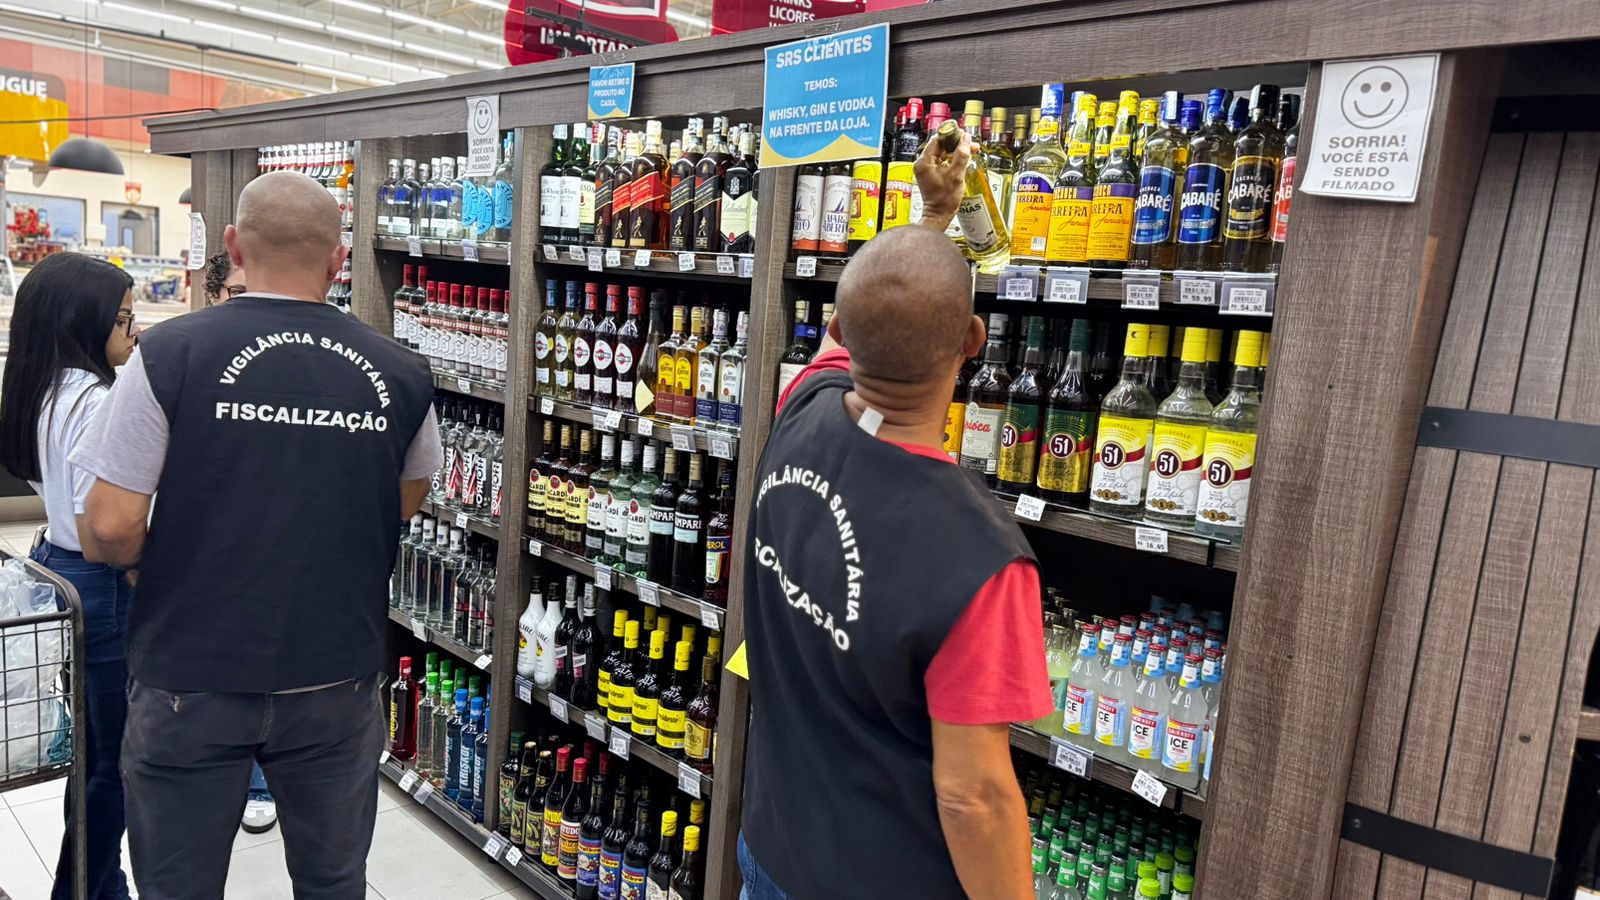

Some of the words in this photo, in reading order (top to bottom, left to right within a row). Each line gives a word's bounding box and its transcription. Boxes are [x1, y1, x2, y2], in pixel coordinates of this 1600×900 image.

[769, 4, 816, 23] LICORES
[776, 49, 802, 69] SRS
[804, 35, 873, 63] CLIENTES
[804, 78, 838, 91] TEMOS:
[769, 105, 808, 121] WHISKY,
[810, 103, 828, 116] GIN
[829, 102, 836, 114] E
[838, 96, 875, 112] VODKA
[769, 127, 783, 139] NA
[784, 121, 823, 137] FRENTE
[824, 119, 839, 132] DA
[840, 115, 870, 131] LOJA.
[1328, 135, 1407, 149] SORRIA!
[1321, 149, 1366, 164] VOCÊ
[1368, 149, 1409, 163] ESTÁ
[1333, 167, 1390, 178] SENDO
[1227, 184, 1272, 203] CABARÉ
[1321, 180, 1395, 192] FILMADO
[1135, 194, 1172, 212] CABARÉ
[1180, 188, 1222, 211] CABARÉ
[219, 331, 315, 386] VIGILÂNCIA
[319, 336, 391, 409] SANITÁRIA
[215, 402, 388, 433] FISCALIZAÇÃO
[1002, 428, 1013, 444] 51
[1054, 437, 1069, 455] 51
[1104, 446, 1119, 464] 51
[1159, 454, 1174, 473] 51
[1210, 463, 1226, 483] 51
[756, 465, 830, 508] IGILÂNCIA
[829, 494, 864, 622] SANITÁRIA
[1170, 737, 1189, 750] ICE
[459, 745, 471, 787] KRISKOF
[1067, 763, 1083, 774] 9.99
